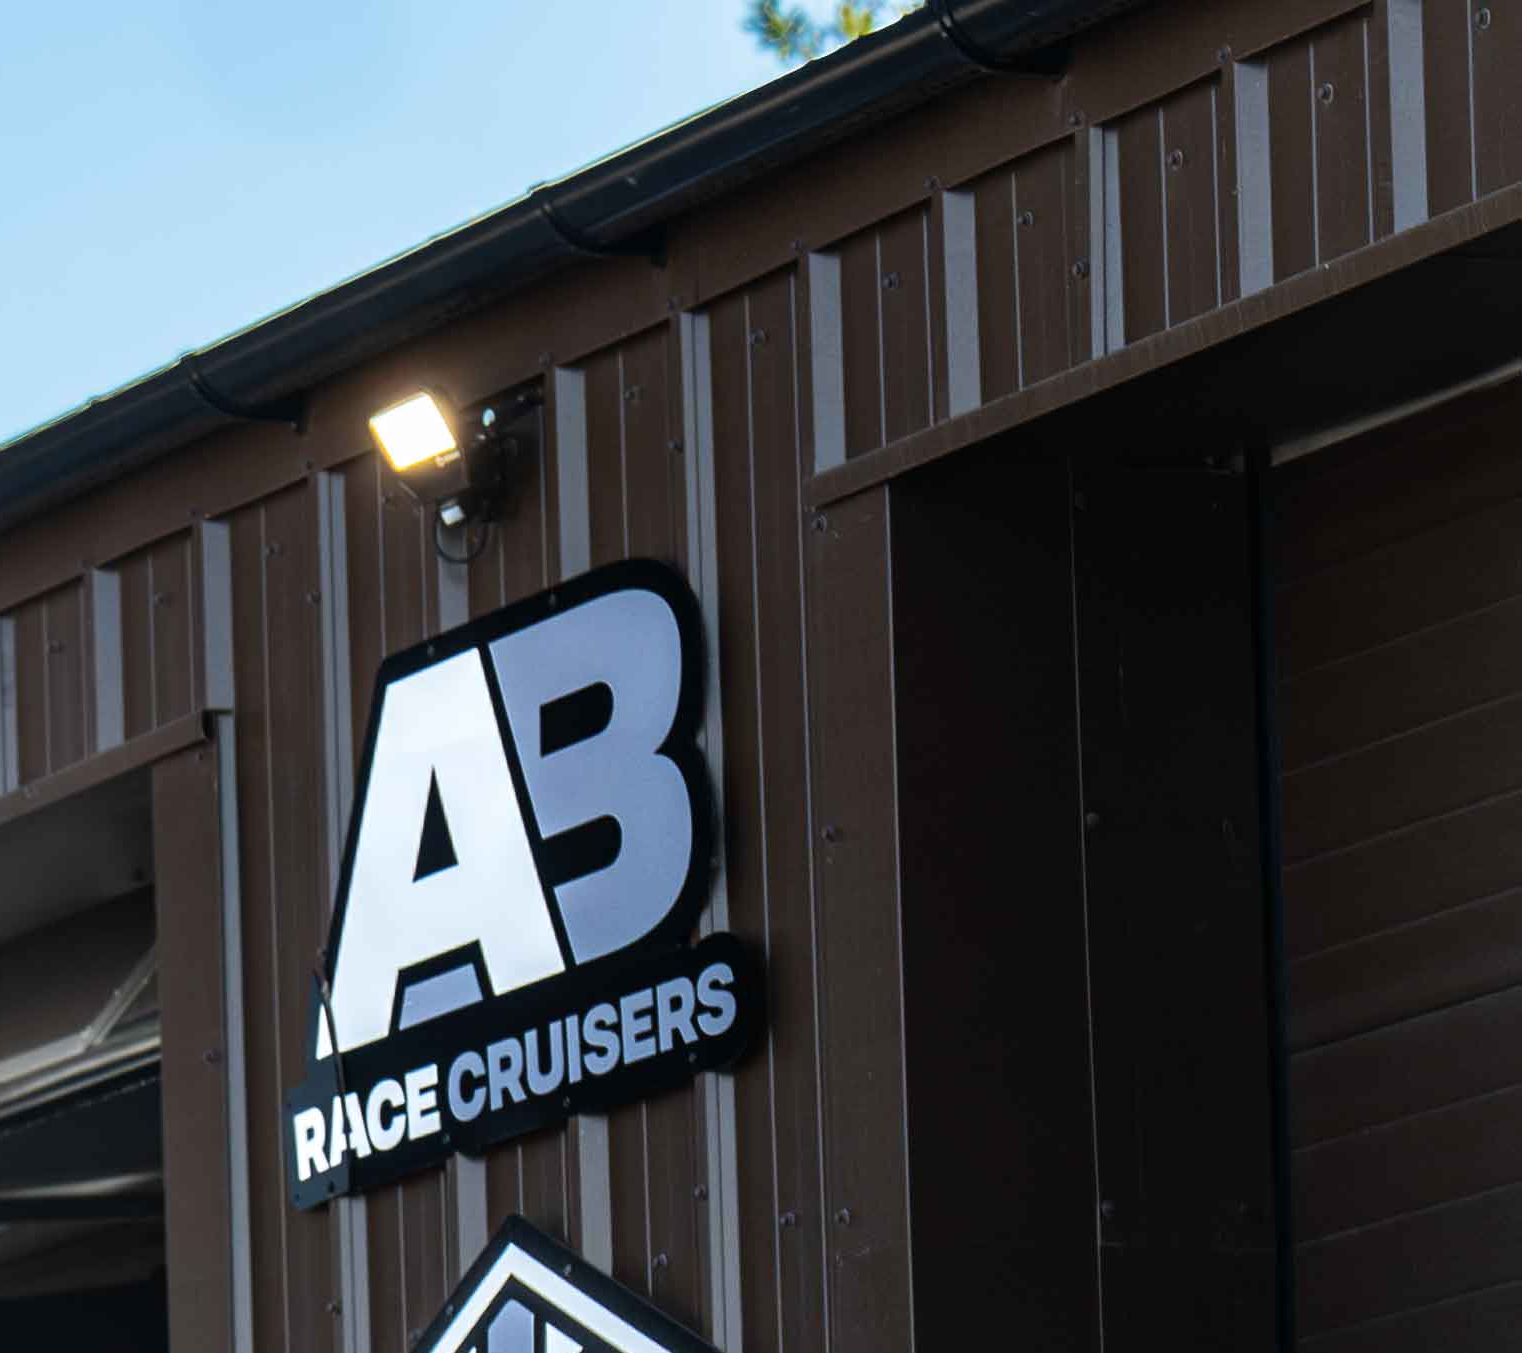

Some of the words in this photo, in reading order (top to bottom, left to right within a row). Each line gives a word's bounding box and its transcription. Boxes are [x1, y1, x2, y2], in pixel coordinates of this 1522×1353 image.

[316, 588, 693, 1060] AB
[293, 1063, 443, 1183] RACE
[446, 961, 738, 1123] CRUISERS
